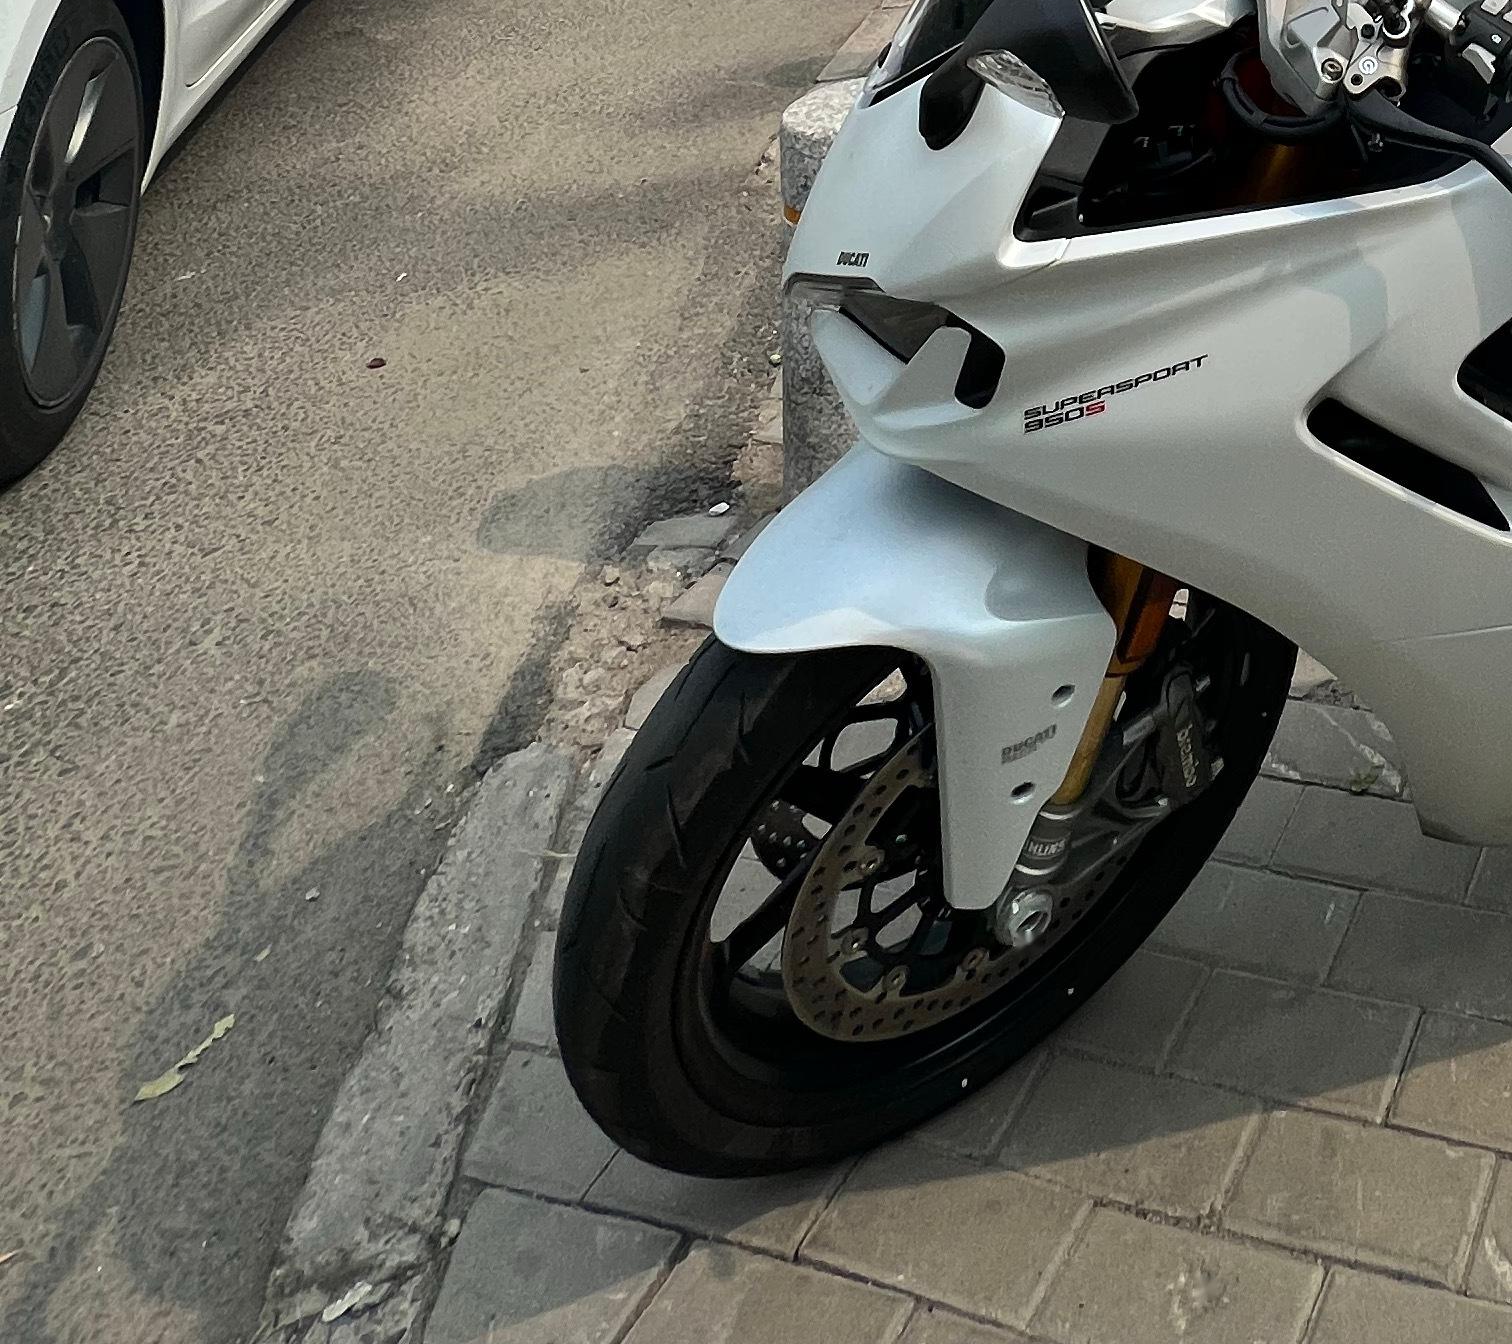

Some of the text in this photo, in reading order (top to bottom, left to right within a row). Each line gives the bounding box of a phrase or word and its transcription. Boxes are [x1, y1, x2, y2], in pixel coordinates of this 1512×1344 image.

[836, 250, 870, 268] DUCATI
[1024, 354, 1208, 420] SUPERSPORT
[1024, 399, 1106, 434] 950S
